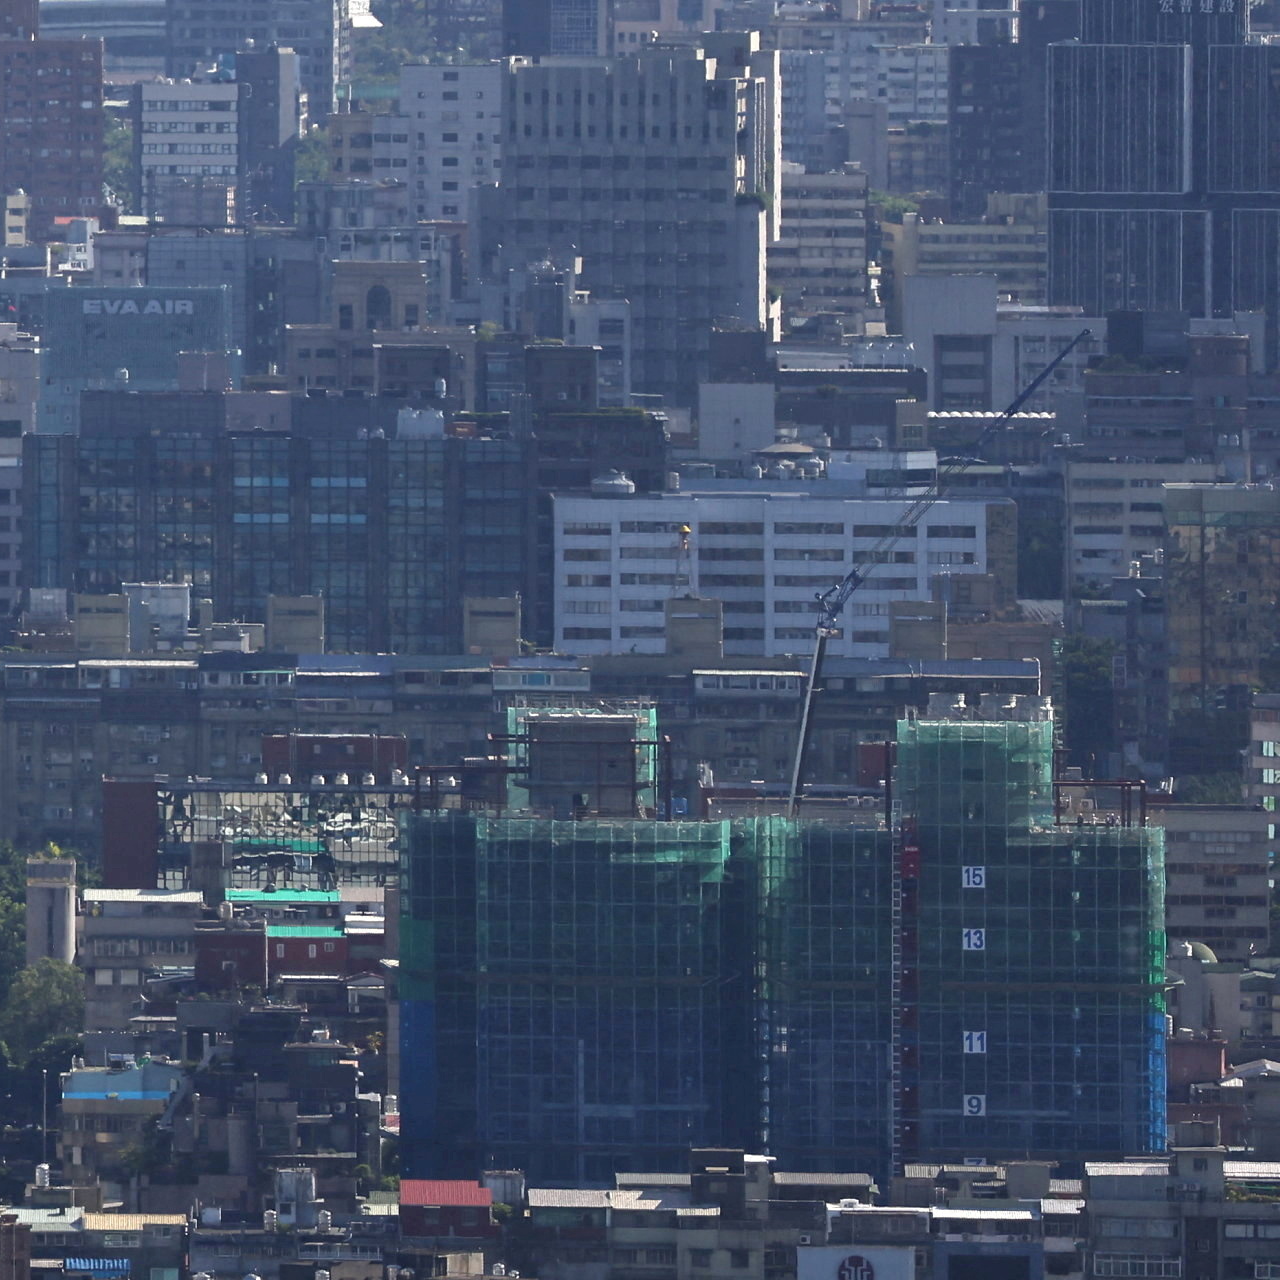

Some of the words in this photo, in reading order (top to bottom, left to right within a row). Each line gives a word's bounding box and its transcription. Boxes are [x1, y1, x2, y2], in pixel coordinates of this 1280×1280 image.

[83, 299, 139, 314] EVA
[144, 299, 193, 315] AIR
[964, 867, 983, 886] 15
[964, 929, 983, 949] 13
[965, 1031, 985, 1052] 11
[967, 1096, 982, 1115] 9
